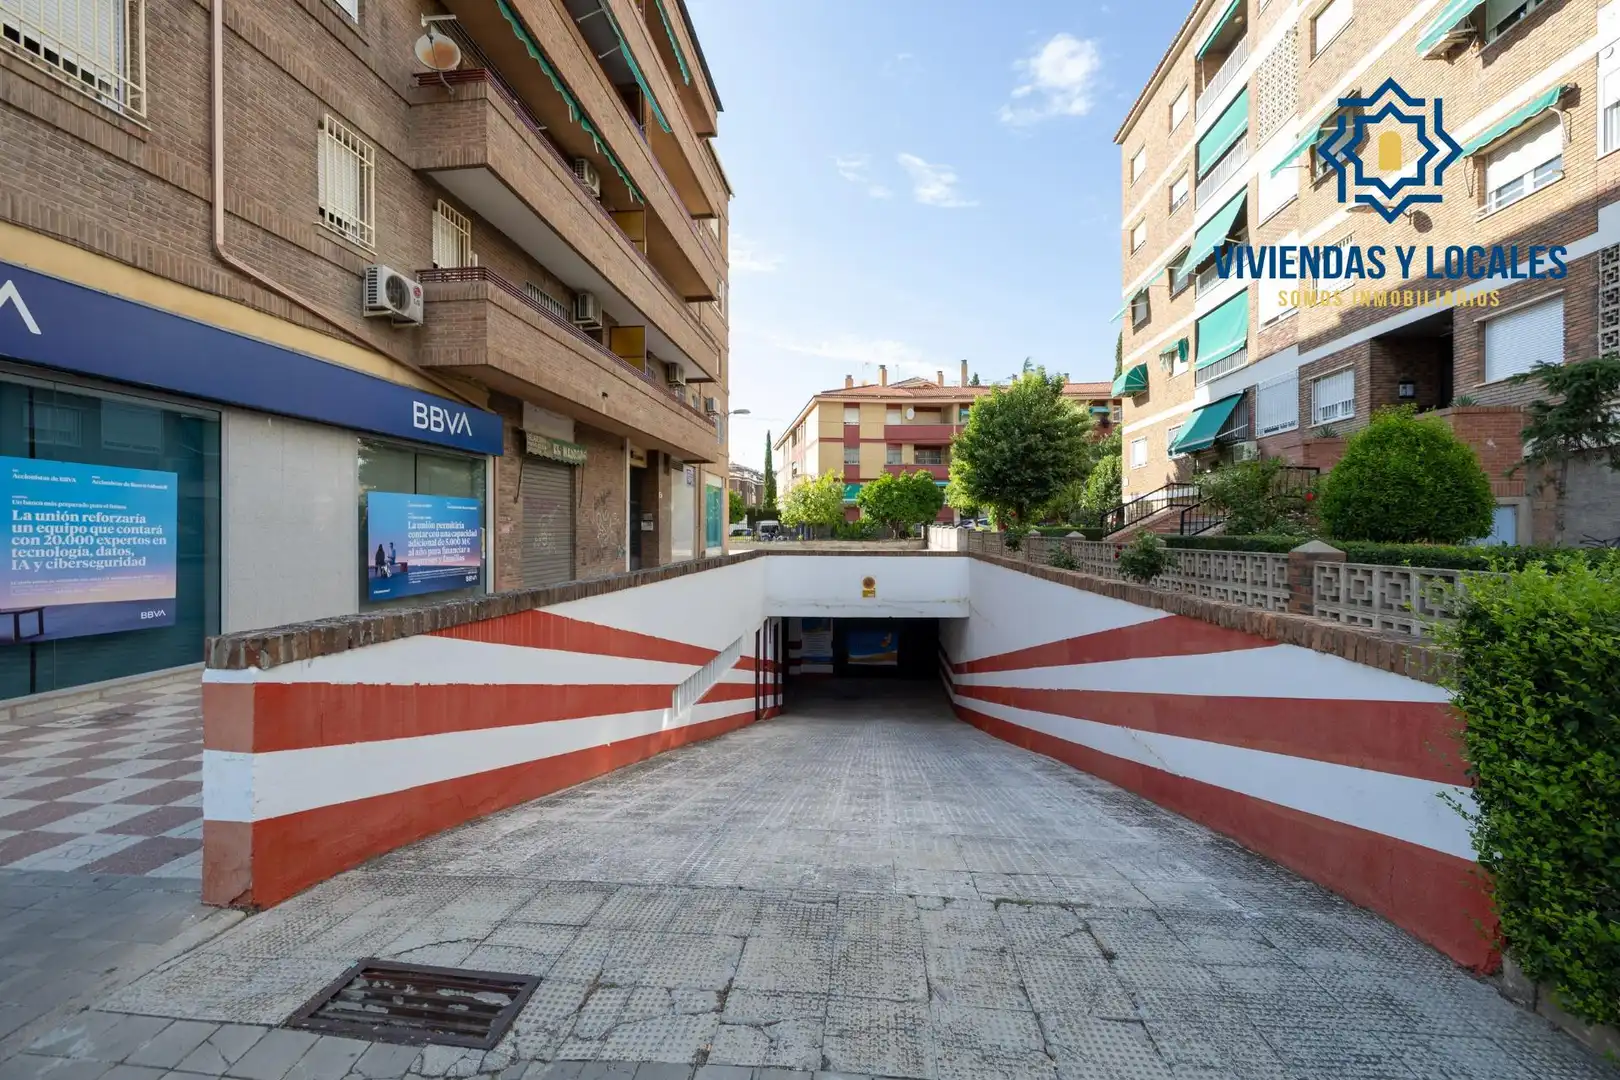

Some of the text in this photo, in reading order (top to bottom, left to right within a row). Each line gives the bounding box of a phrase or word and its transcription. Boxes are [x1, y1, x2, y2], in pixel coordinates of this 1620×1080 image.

[412, 400, 473, 437] BBVA
[12, 509, 147, 525] La unión reforzaría
[12, 522, 163, 537] un equipo que contará
[12, 534, 167, 548] con 20.000 expertos en
[12, 545, 135, 560] tecnología, datos,
[12, 556, 147, 573] IA y ciberseguridad
[465, 575, 478, 583] BBVA
[140, 609, 166, 620] BBVA
